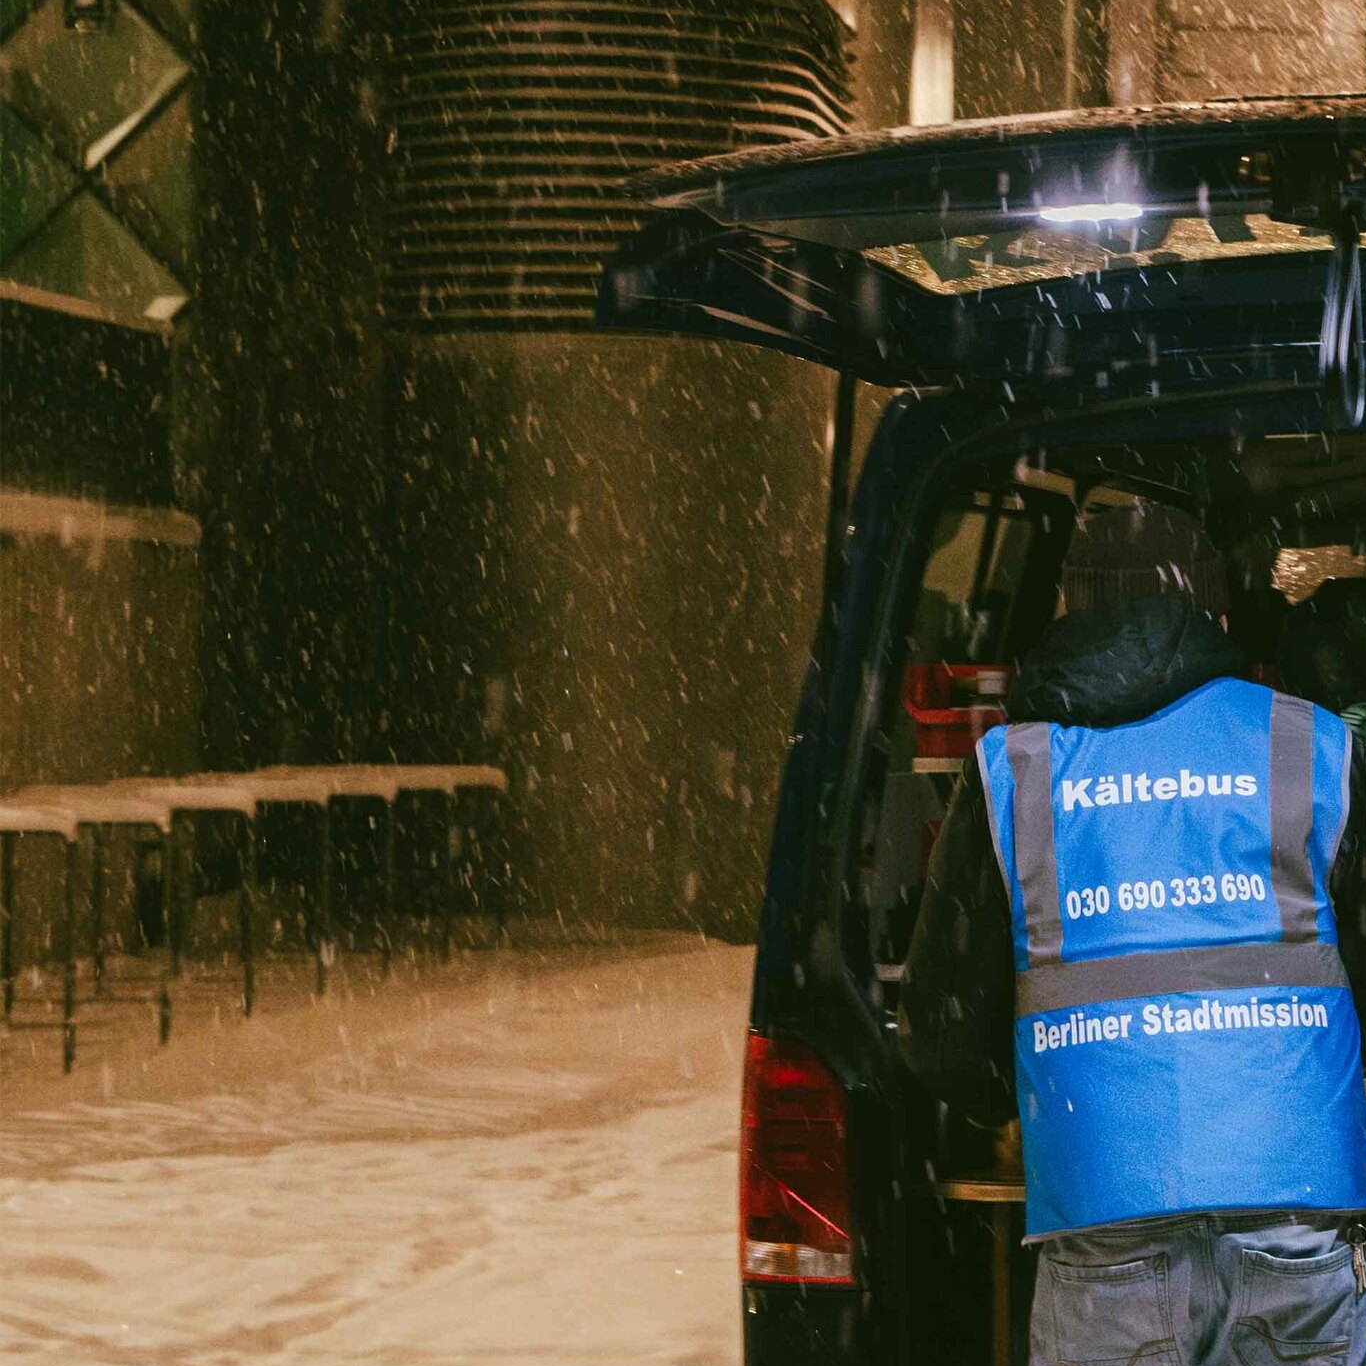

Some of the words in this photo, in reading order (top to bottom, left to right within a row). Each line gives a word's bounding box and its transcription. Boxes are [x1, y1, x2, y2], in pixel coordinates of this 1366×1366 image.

[1061, 769, 1258, 812] Kältebus
[1066, 885, 1110, 920] 030
[1117, 878, 1166, 912] 690
[1169, 874, 1218, 908] 333
[1220, 873, 1266, 903] 690
[1033, 1012, 1133, 1053] Berliner
[1142, 995, 1328, 1036] Stadtmission
